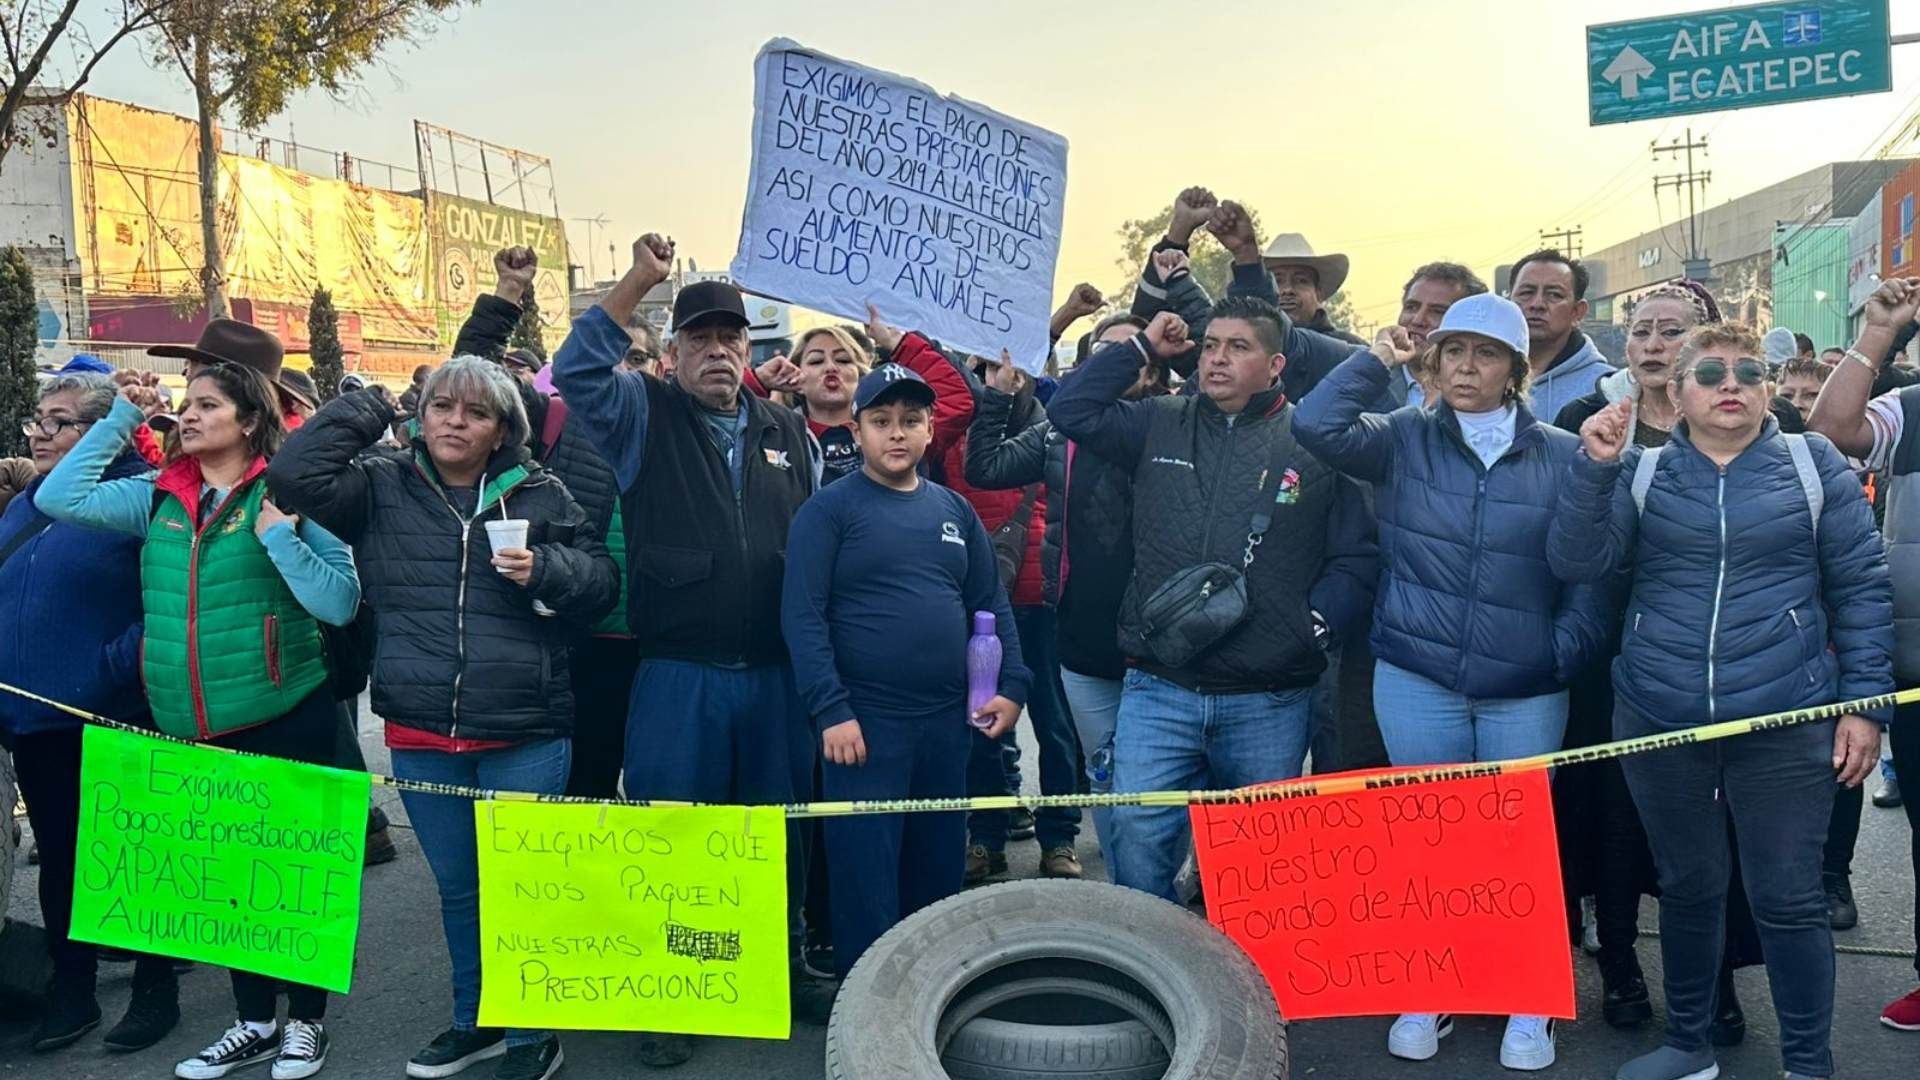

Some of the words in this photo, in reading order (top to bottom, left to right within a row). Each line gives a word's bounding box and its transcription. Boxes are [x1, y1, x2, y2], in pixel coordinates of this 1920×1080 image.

[1668, 19, 1771, 61] AIFA
[782, 51, 891, 115] EXIGIMOS
[906, 95, 937, 128] EL
[944, 107, 990, 148] PAGO
[1001, 129, 1031, 166] DE
[1668, 49, 1862, 102] ECATEPEC
[776, 120, 829, 162] DEL
[833, 138, 884, 177] AÑO
[888, 155, 927, 191] 2019
[978, 184, 1042, 238] FECHA
[779, 89, 907, 152] NUESTRAS
[915, 127, 1052, 207] PRESTACIONES
[766, 167, 813, 203] ASI
[828, 182, 908, 226] COMO
[918, 204, 1031, 271] NUESTROS
[800, 208, 936, 265] AUMENTOS
[955, 247, 985, 288] DE
[759, 228, 870, 285] SUELDO
[891, 262, 1013, 333] ANUALES
[148, 749, 272, 815] Exigimos
[1204, 800, 1364, 856] Exigimos
[1380, 788, 1465, 848] pago
[1478, 774, 1523, 821] de
[93, 780, 175, 846] Pagos
[179, 813, 205, 843] de
[210, 815, 356, 862] prestaciones
[492, 806, 673, 867] EXIGIMOS
[706, 830, 769, 862] QUE
[515, 880, 585, 901] NOS
[1216, 837, 1377, 897] nuestro
[1217, 891, 1337, 940] Fondo
[1350, 882, 1393, 923] de
[496, 932, 643, 958] NUESTRAS
[519, 959, 739, 1004] PRESTACIONES
